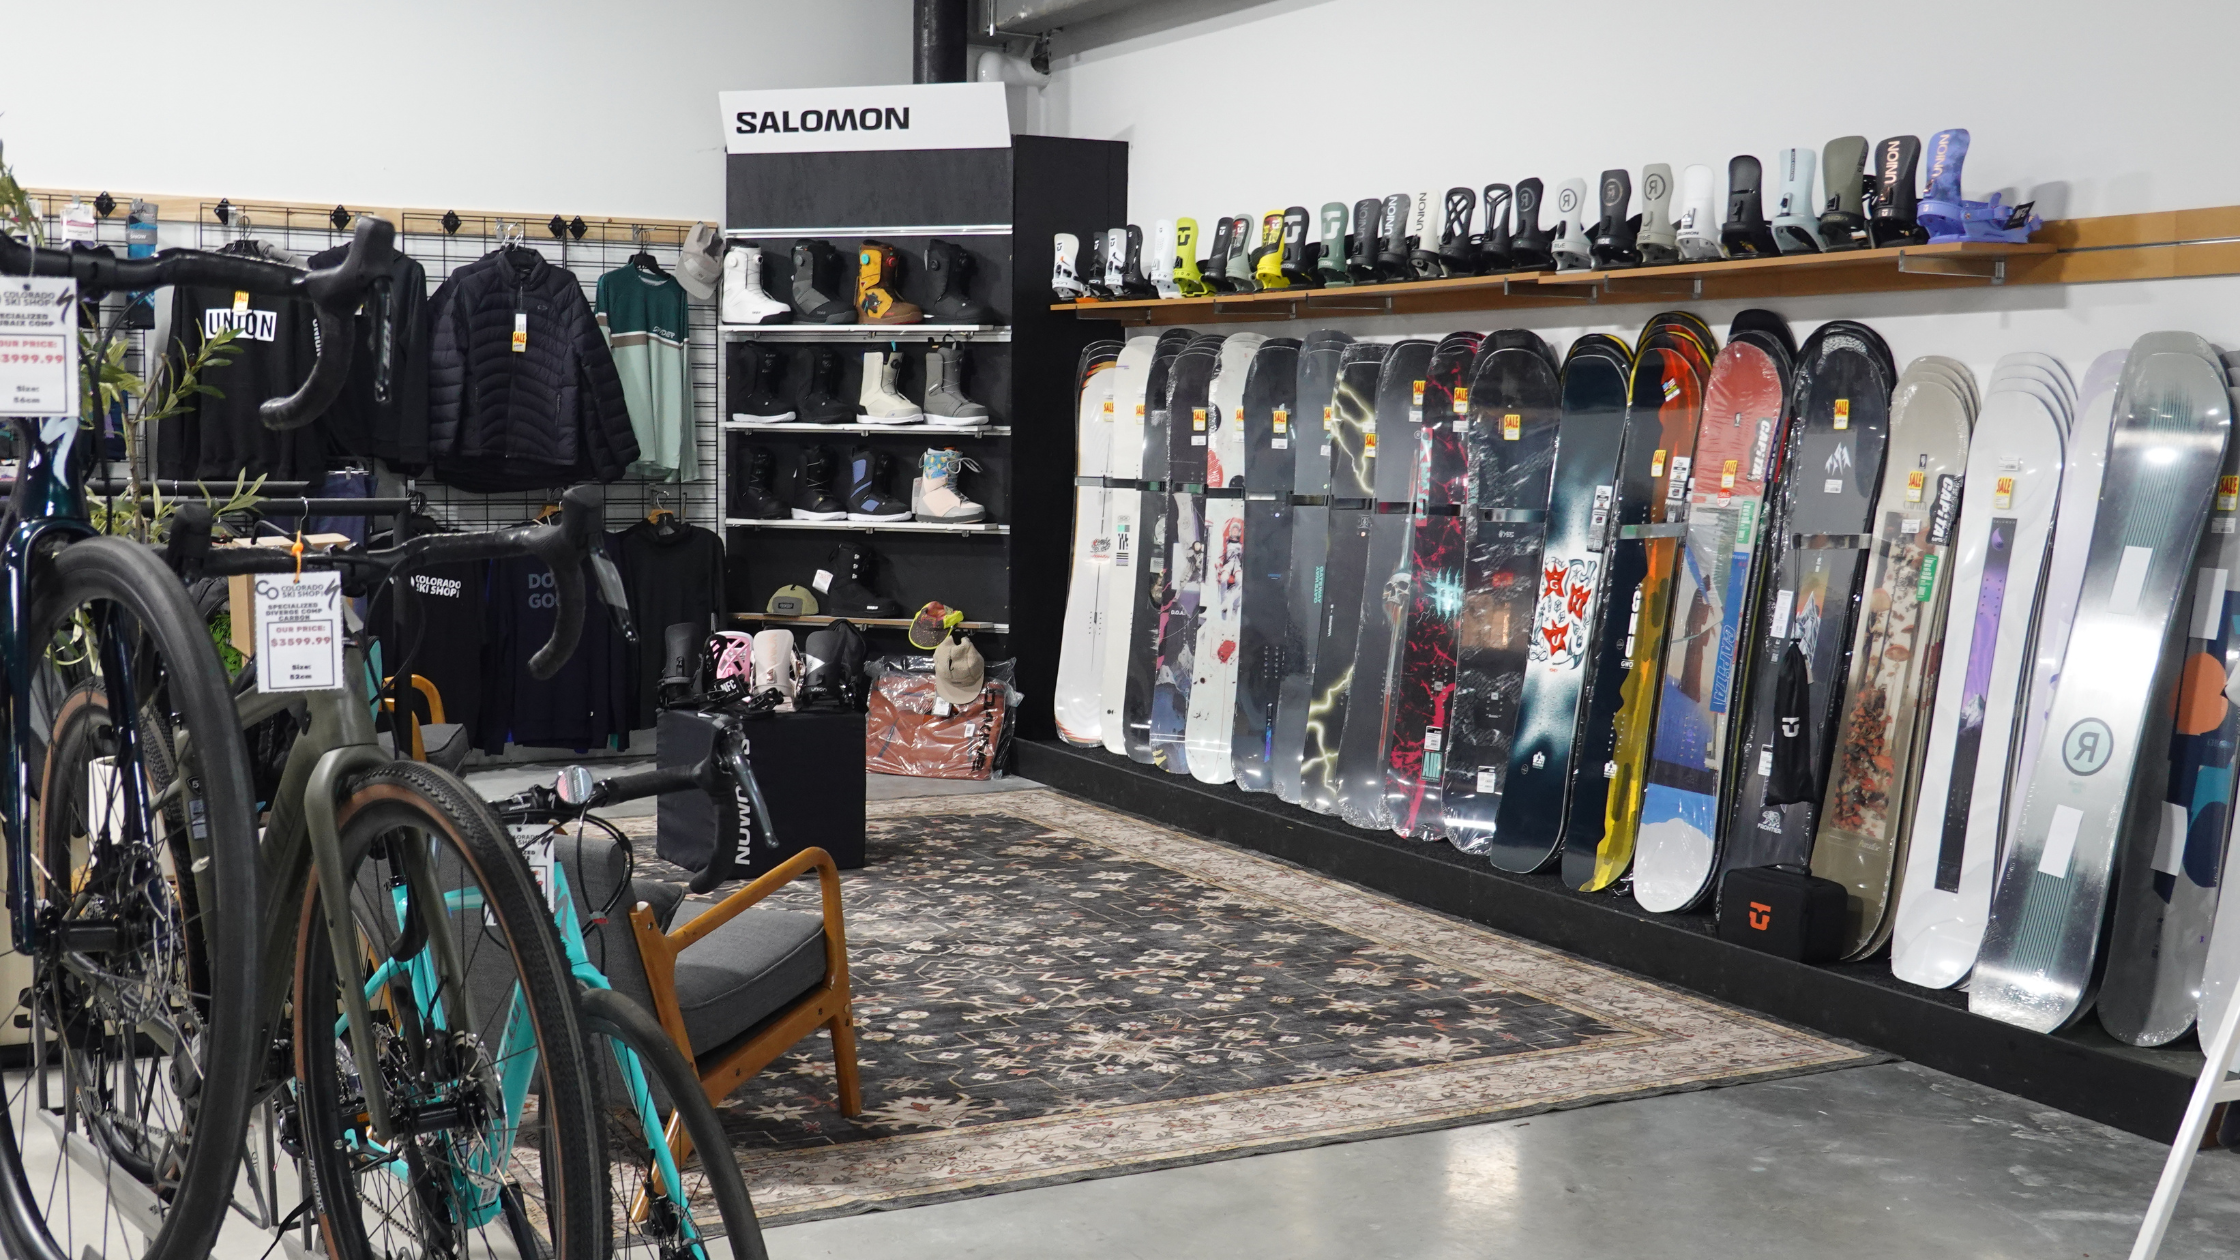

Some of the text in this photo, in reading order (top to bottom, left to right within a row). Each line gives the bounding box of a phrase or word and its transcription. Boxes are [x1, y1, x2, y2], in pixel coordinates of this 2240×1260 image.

[736, 107, 910, 134] SALOMON
[1932, 133, 1950, 177] UNION
[1884, 141, 1900, 184] UNION
[1385, 196, 1398, 236] UNION
[1416, 192, 1427, 232] UNION
[3, 291, 56, 300] COLORADO
[4, 298, 51, 307] SKI SHOP
[235, 291, 249, 302] SALE
[208, 312, 274, 338] UNION
[22, 340, 58, 348] PRICE:
[513, 332, 526, 344] SALE
[16, 385, 40, 393] Size:
[1414, 381, 1425, 396] SAL
[1455, 388, 1468, 402] SALE
[1193, 409, 1206, 421] SALE
[1834, 400, 1848, 416] SALE
[1274, 410, 1286, 423] SALE
[1505, 416, 1519, 429] SALE
[1653, 451, 1665, 465] SALE
[1722, 461, 1737, 476] SALE
[1908, 471, 1923, 489] SALE
[1996, 478, 2012, 495] SALE
[2218, 477, 2239, 496] SALE
[281, 584, 324, 592] COLORADO
[415, 574, 462, 590] COLORADO
[299, 590, 320, 598] SHOP
[416, 583, 457, 598] SKI SHOP
[268, 602, 318, 610] SPECIALIZED
[528, 593, 559, 609] GO
[271, 636, 331, 647] $3599.99
[720, 679, 737, 693] NFC
[1423, 751, 1442, 778] AIR
[1757, 822, 1782, 835] FRONTIER
